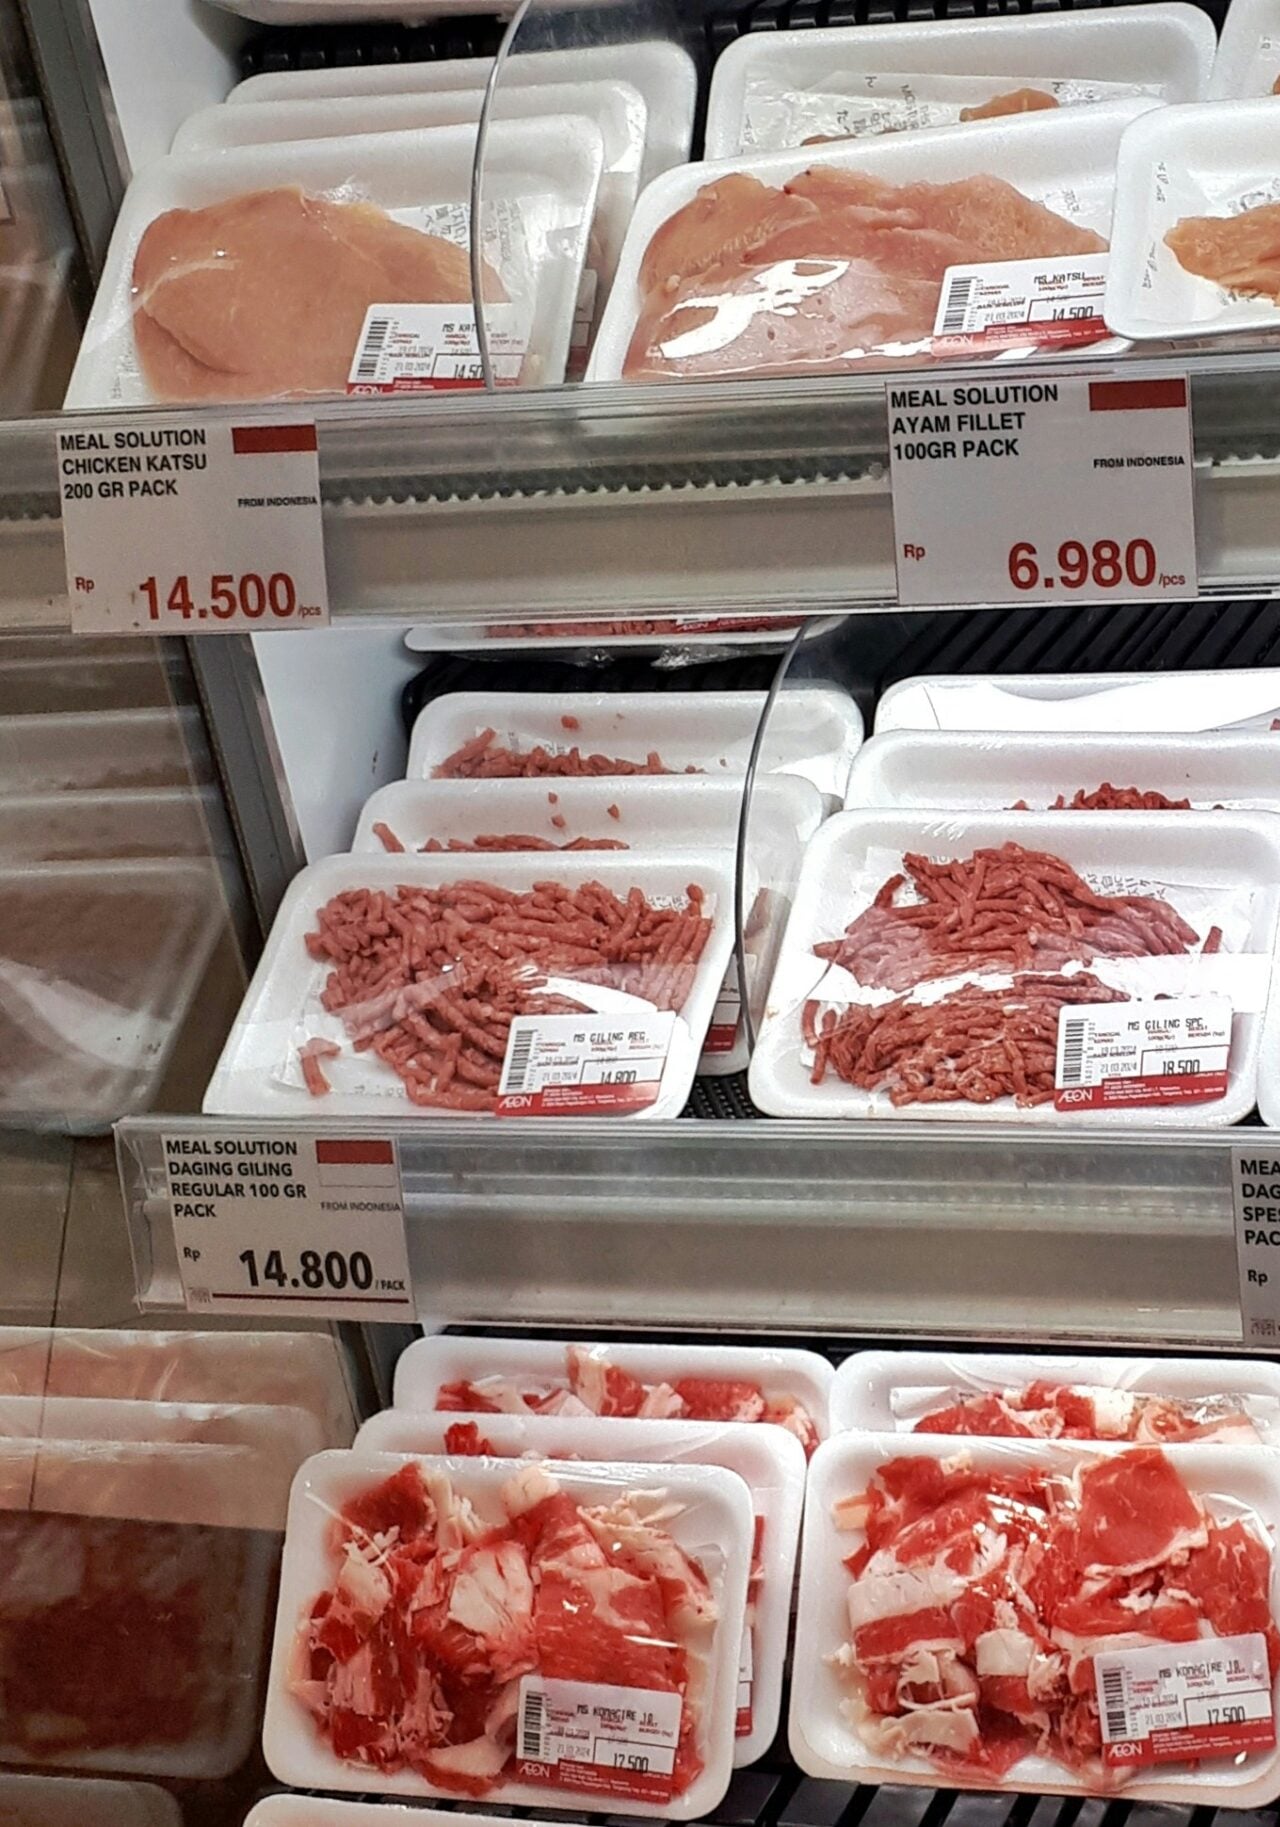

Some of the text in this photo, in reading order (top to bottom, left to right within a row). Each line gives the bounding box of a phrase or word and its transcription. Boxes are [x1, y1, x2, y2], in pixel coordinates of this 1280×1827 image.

[1052, 305, 1093, 321] 14500
[454, 363, 497, 378] 1450
[890, 384, 1058, 408] MEAL SOLUTION
[892, 412, 1026, 435] AYAM FILLET
[60, 429, 207, 451] MEAL SOLUTION
[894, 439, 1019, 460] 100GR PACK
[62, 454, 207, 475] CHICKEN KATSU
[1093, 455, 1185, 469] FROM INDONESIA
[64, 479, 178, 499] 200 GR PACK
[238, 496, 318, 508] FROM INDONESIA
[903, 538, 1186, 590] Rp 6.980 /pcs
[75, 572, 321, 620] Rp 14.500 /pcs
[1127, 1017, 1203, 1030] MS GILING SPC
[573, 1033, 586, 1043] MS
[590, 1032, 623, 1042] GILING
[1162, 1059, 1200, 1077] 18500
[600, 1070, 637, 1084] 14800
[166, 1140, 298, 1156] MEAL SOLUTION
[168, 1162, 293, 1177] DAGING GILING
[171, 1183, 307, 1199] REGULAR 100 GR
[174, 1203, 216, 1218] PACK
[320, 1201, 400, 1212] FROM INDONESIA
[183, 1246, 201, 1262] Rp
[239, 1249, 373, 1290] 14.800
[1247, 1269, 1269, 1287] Rp
[576, 1704, 589, 1714] MS
[1207, 1705, 1246, 1727] 17500
[613, 1752, 649, 1772] 17500
